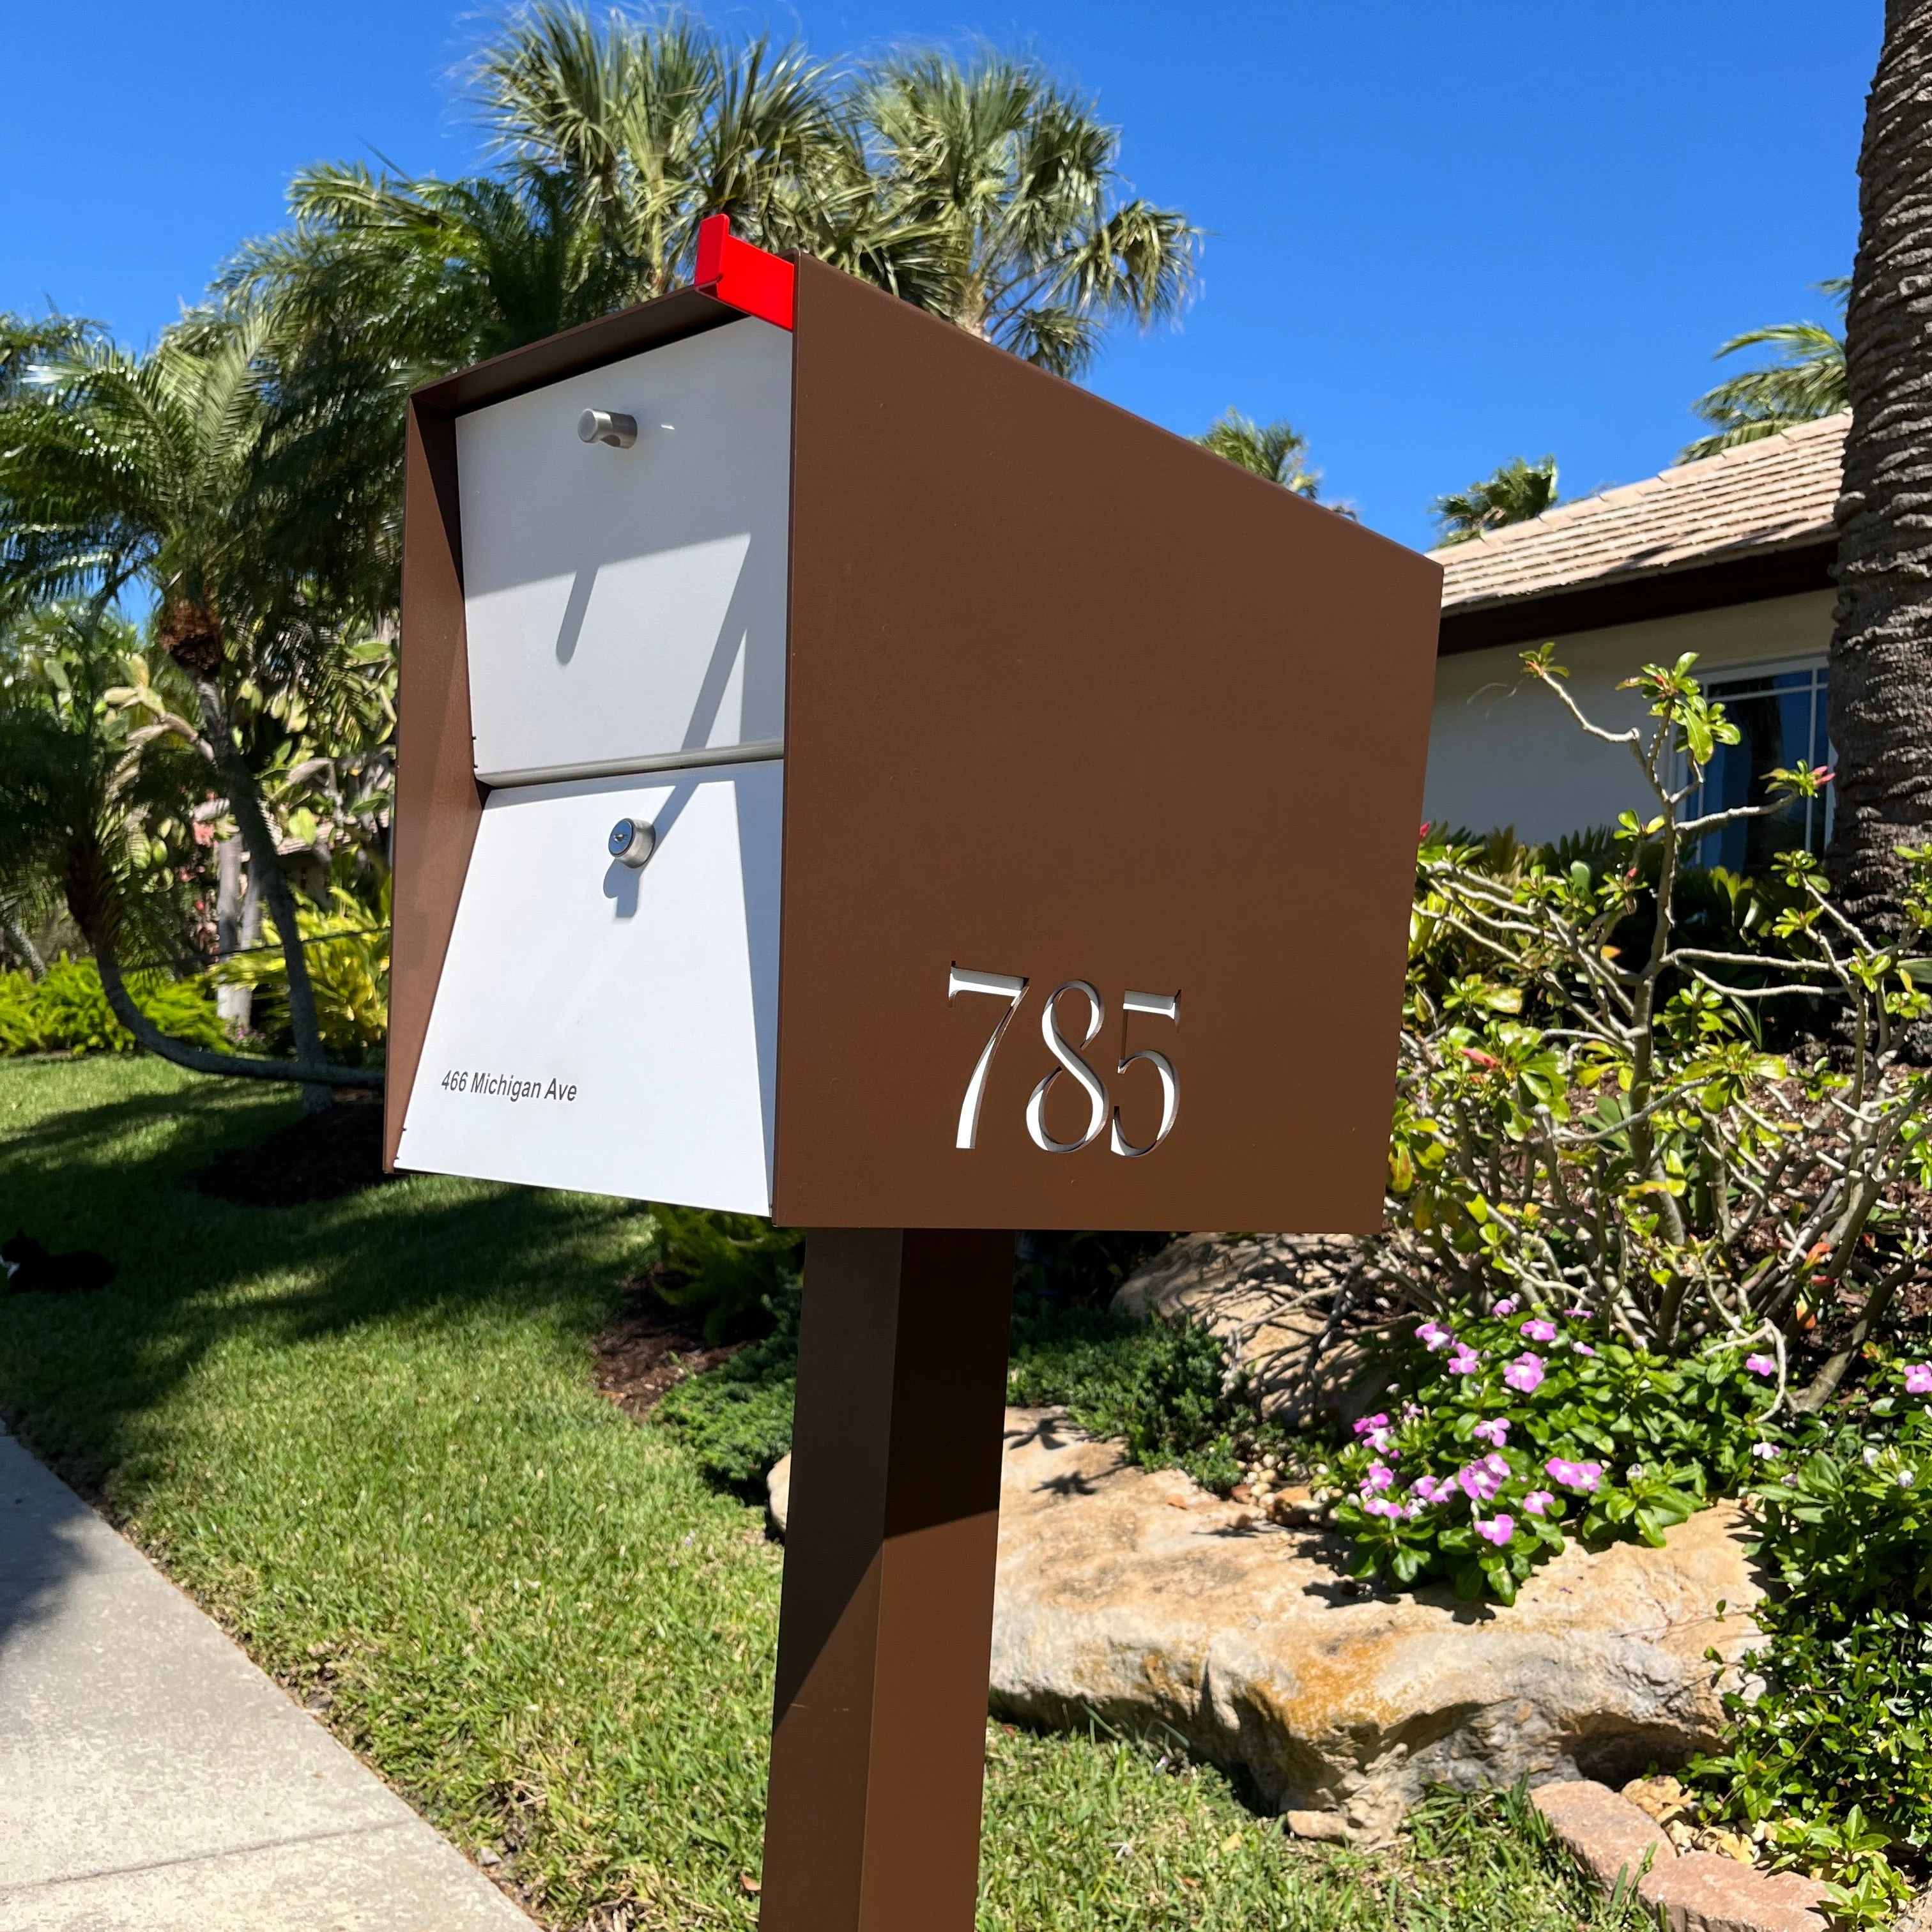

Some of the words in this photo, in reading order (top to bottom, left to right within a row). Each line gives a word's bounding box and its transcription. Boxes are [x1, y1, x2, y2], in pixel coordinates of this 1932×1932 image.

[441, 1070, 468, 1092] 466
[470, 1072, 542, 1102] Michigan
[544, 1078, 577, 1101] Ave
[948, 960, 1182, 1158] 785
